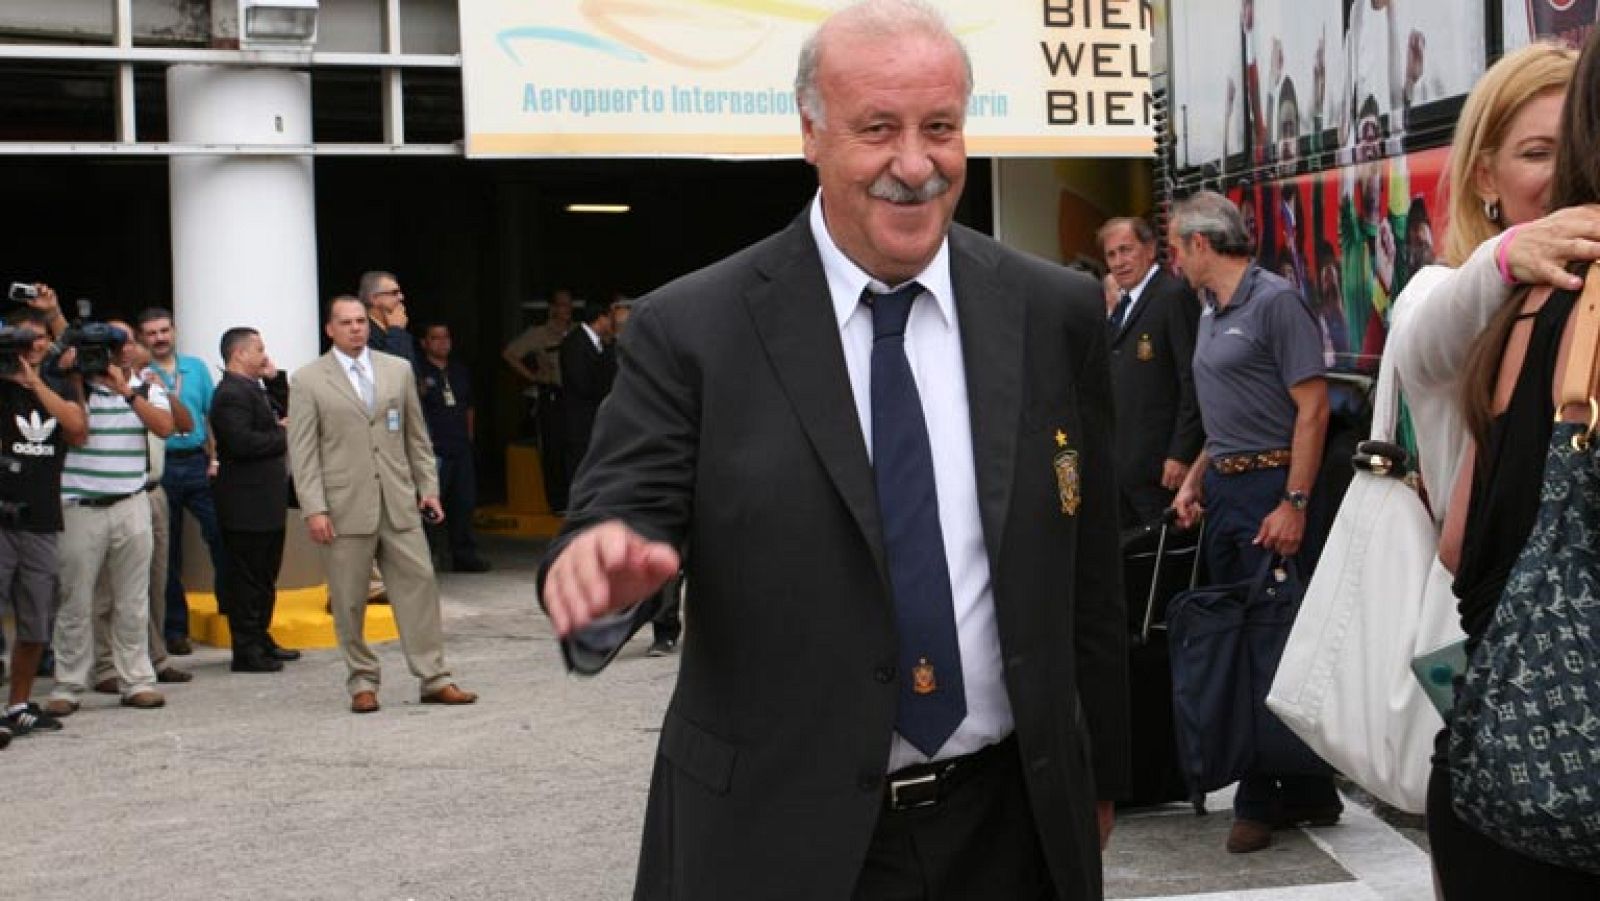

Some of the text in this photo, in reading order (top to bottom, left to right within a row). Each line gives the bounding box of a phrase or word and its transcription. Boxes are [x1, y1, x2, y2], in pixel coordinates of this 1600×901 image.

[1040, 41, 1149, 77] WEL
[521, 82, 664, 117] Aeropuerto
[12, 442, 55, 456] adidas
